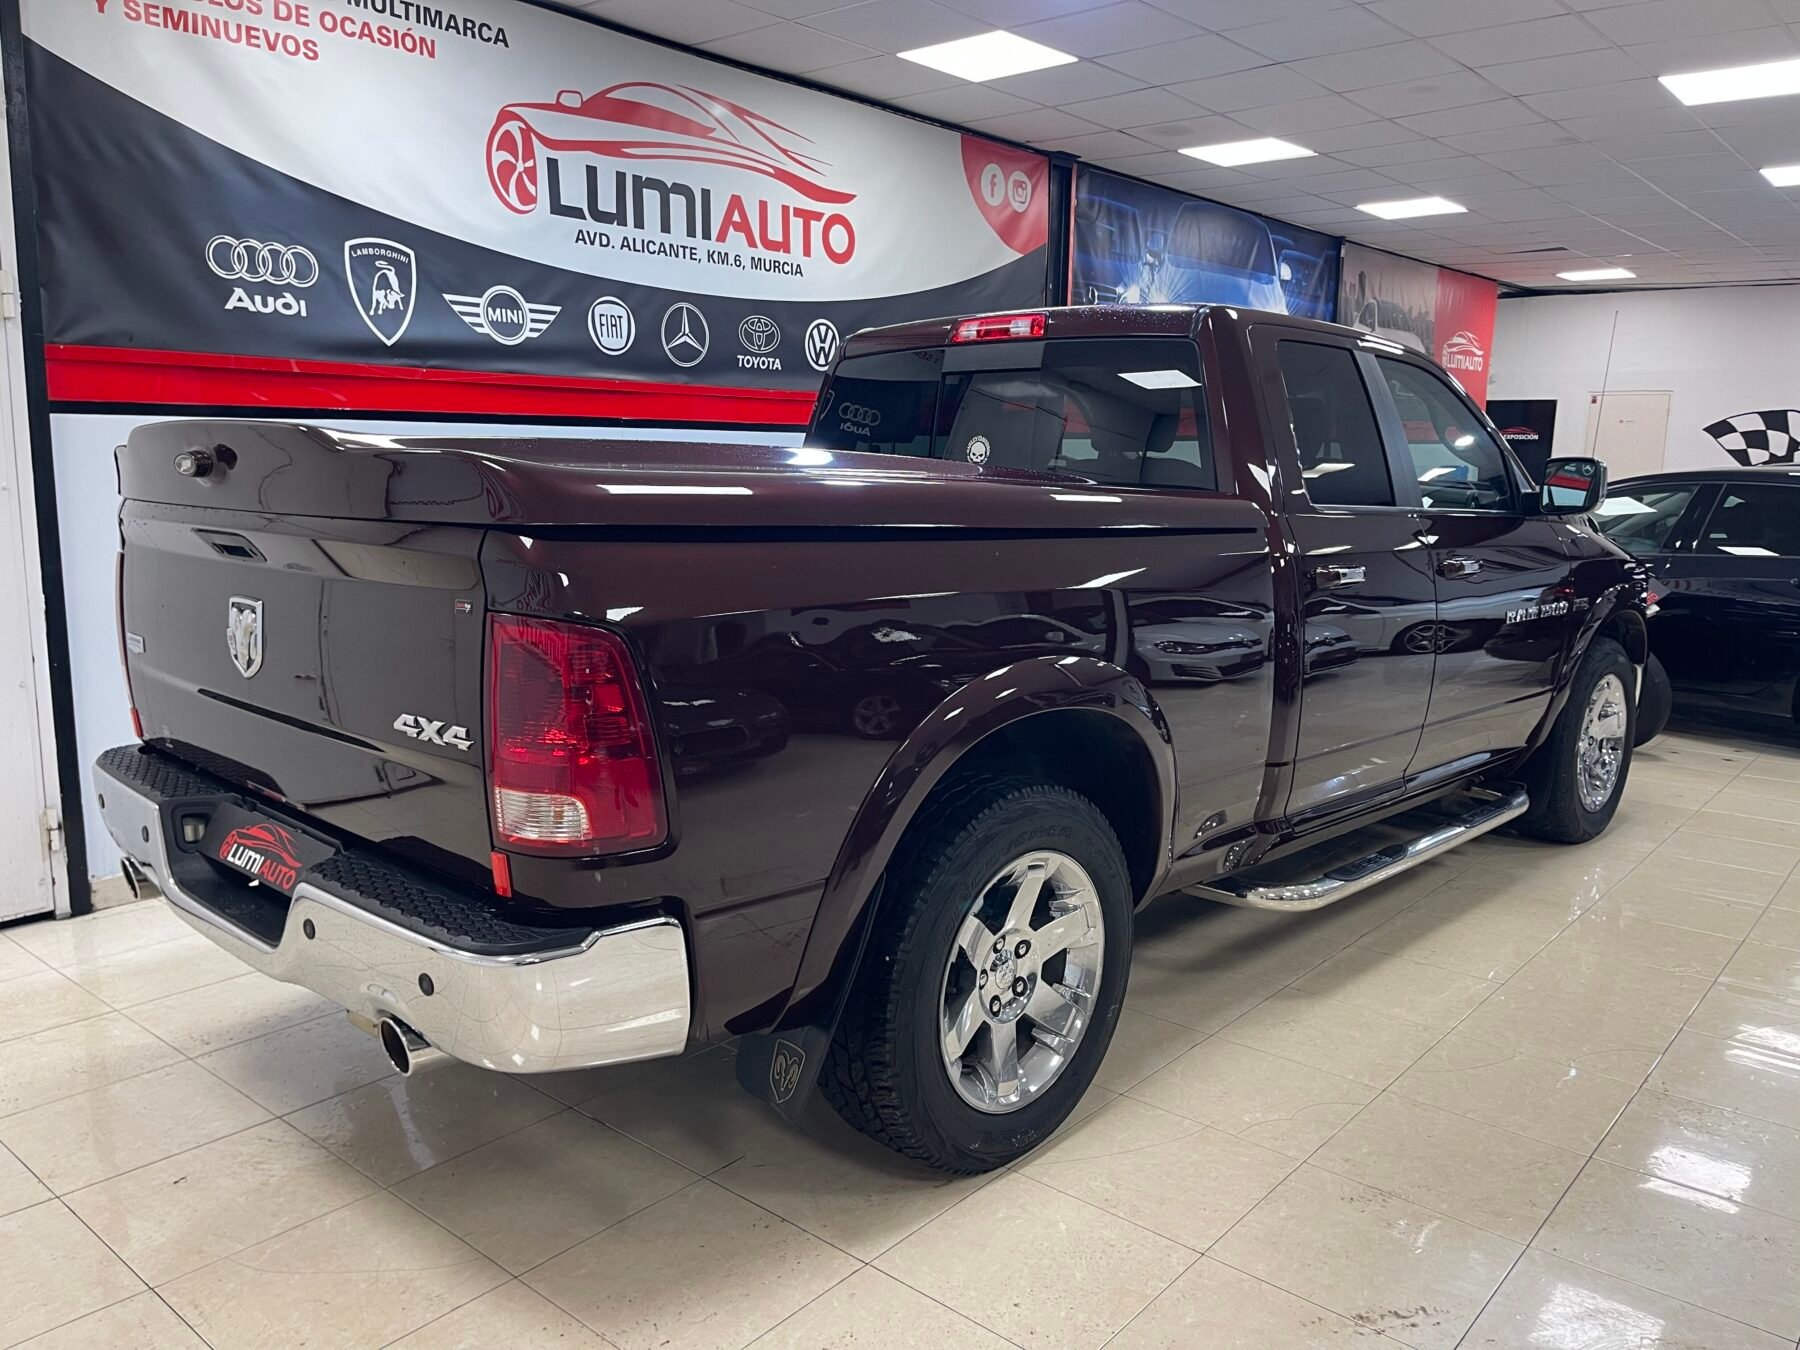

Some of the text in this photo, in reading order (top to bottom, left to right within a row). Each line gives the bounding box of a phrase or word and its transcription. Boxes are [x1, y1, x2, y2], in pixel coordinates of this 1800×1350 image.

[123, 0, 319, 61] SEMINUEVOS
[273, 0, 436, 59] DE OCASIÓN
[351, 247, 409, 264] LAMBORGHINI
[575, 229, 804, 277] AVD. ALICANTE, KM.6, MURCIA
[224, 287, 307, 317] Audi
[487, 306, 524, 324] MINI
[599, 313, 624, 340] FIAT
[737, 355, 781, 371] TOYOTA
[1506, 606, 1539, 624] RAM
